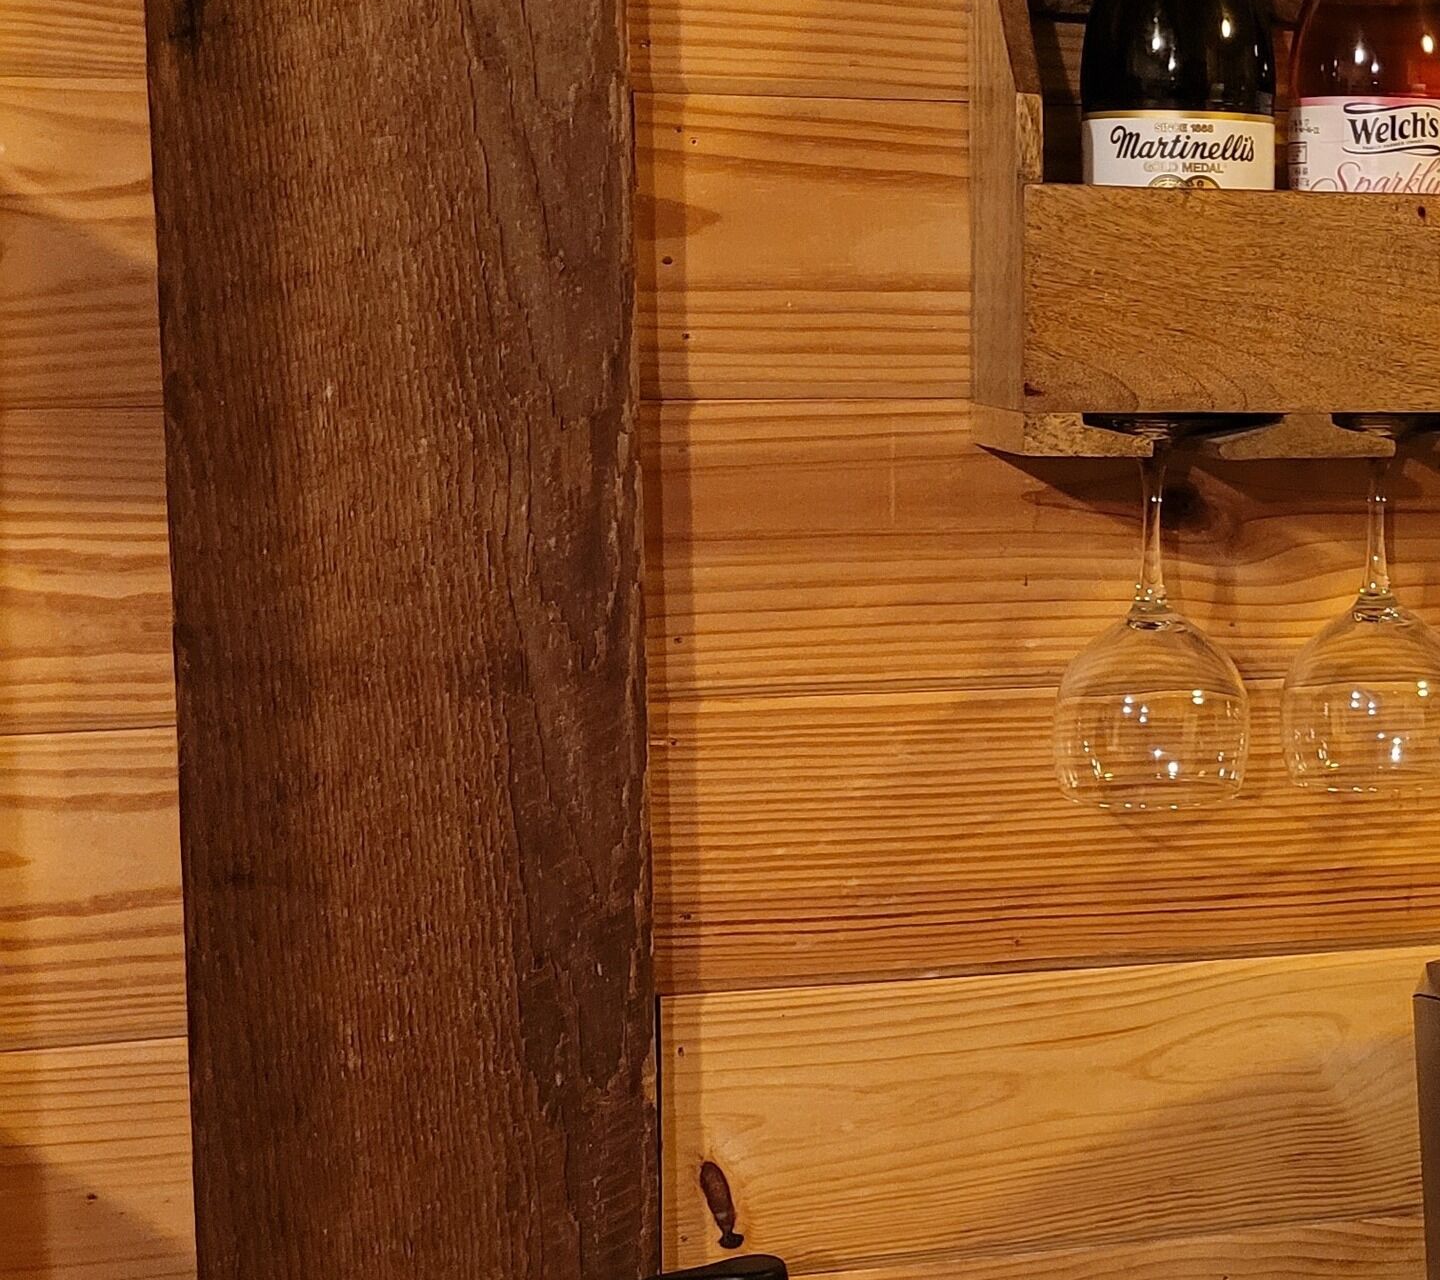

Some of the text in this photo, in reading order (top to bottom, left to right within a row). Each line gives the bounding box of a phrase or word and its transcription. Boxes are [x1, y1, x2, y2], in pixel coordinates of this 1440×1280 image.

[1110, 125, 1255, 162] Martinelli's
[1347, 112, 1440, 145] Welch's
[1182, 162, 1224, 174] MEDAL
